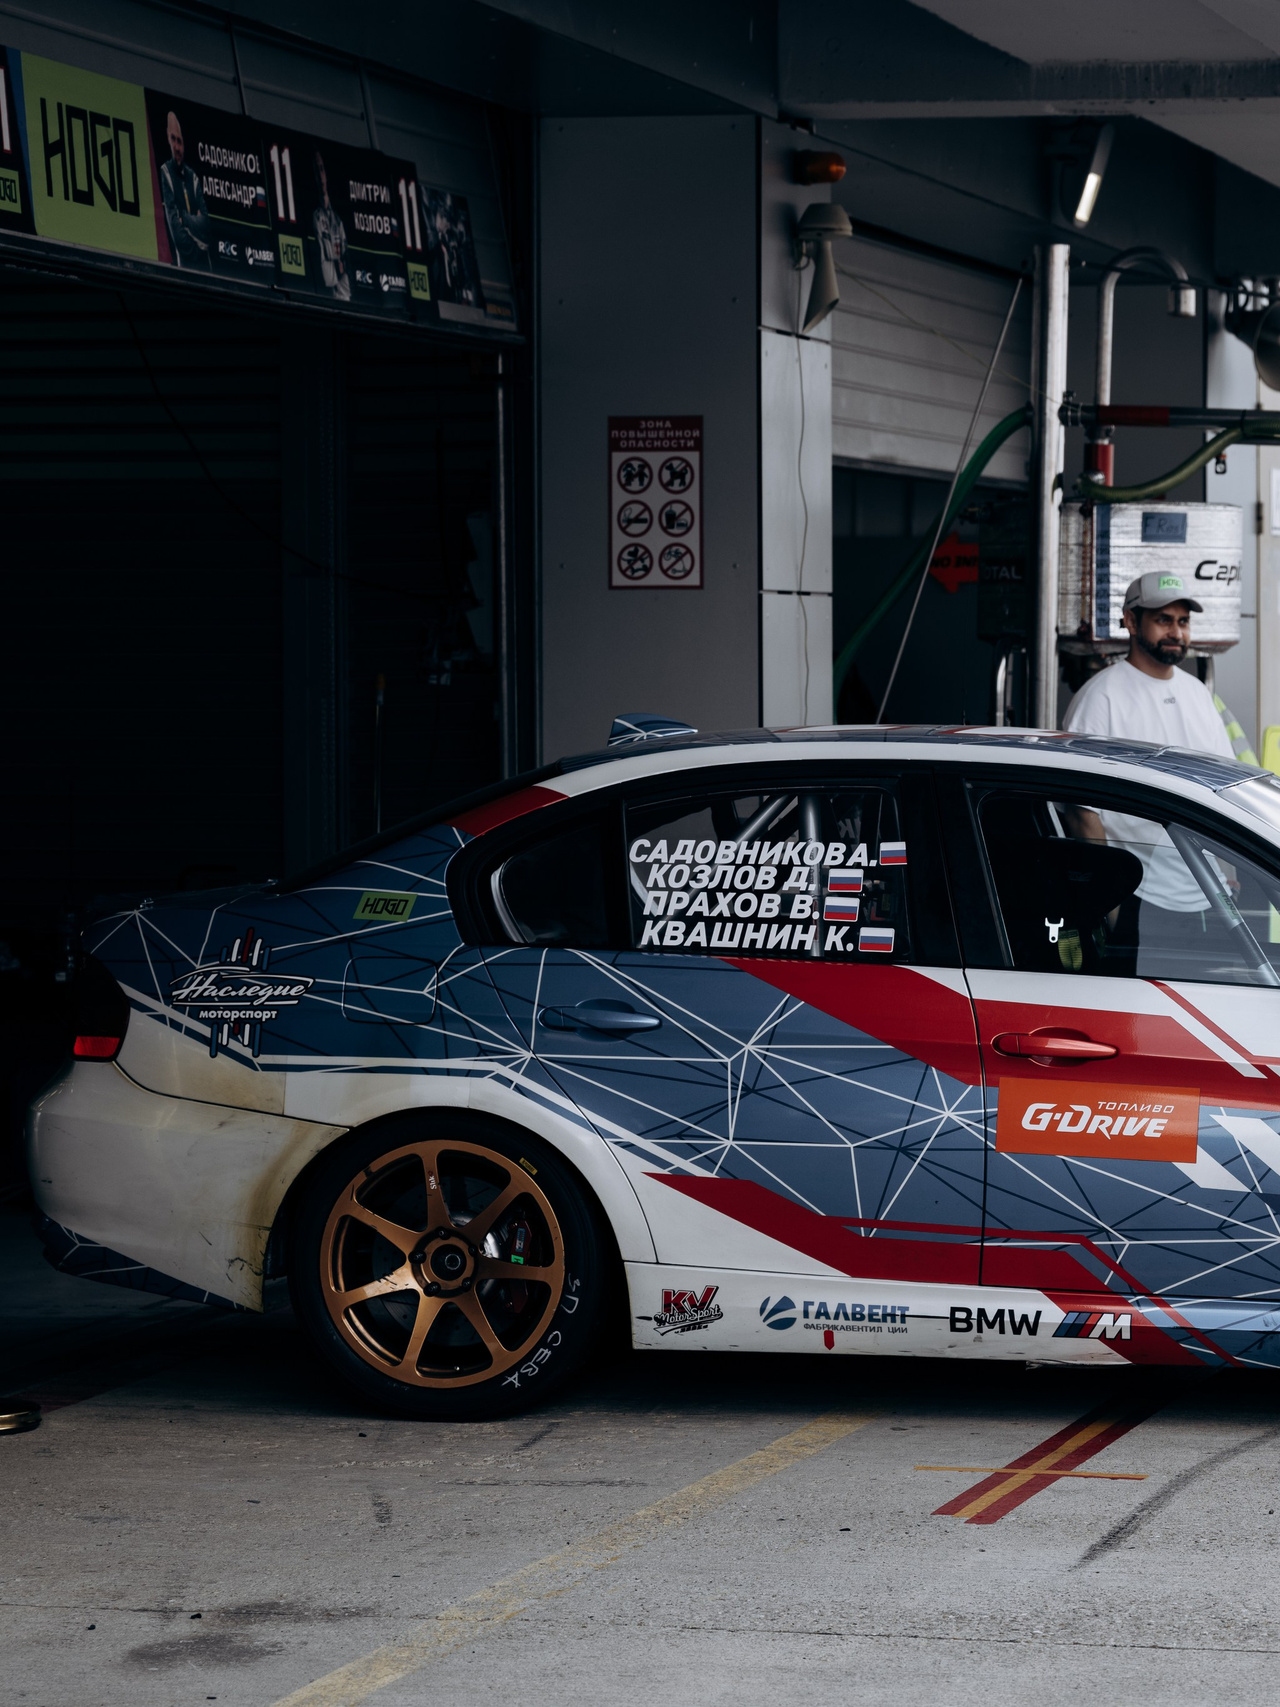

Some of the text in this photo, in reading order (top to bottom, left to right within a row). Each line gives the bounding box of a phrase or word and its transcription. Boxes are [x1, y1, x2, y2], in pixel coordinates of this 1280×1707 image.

[40, 98, 140, 217] HOGO
[0, 176, 17, 203] OGO
[202, 175, 257, 209] АЛЕКСАНДР
[269, 142, 297, 224] 11
[353, 211, 391, 235] КОЗЛОВ
[398, 176, 422, 254] 11
[611, 428, 701, 439] ПОВЫШЕННОЙ
[640, 420, 672, 429] ЗОНА
[620, 439, 696, 449] ОПАСНОСТИ
[983, 564, 1023, 580] OTAL
[646, 864, 817, 891] КОЗЛОВ Д.
[361, 897, 409, 916] HOGO
[643, 891, 820, 920] ПРАХОВ В.
[640, 920, 854, 952] КВАШНИН К.
[172, 970, 307, 1006] Наследие
[1097, 1101, 1175, 1114] ТОПЛИВО
[662, 1285, 719, 1314] KV
[803, 1301, 910, 1324] ГАЛВЕНТ
[887, 1326, 908, 1334] ЦИИ
[949, 1306, 1042, 1336] BMW
